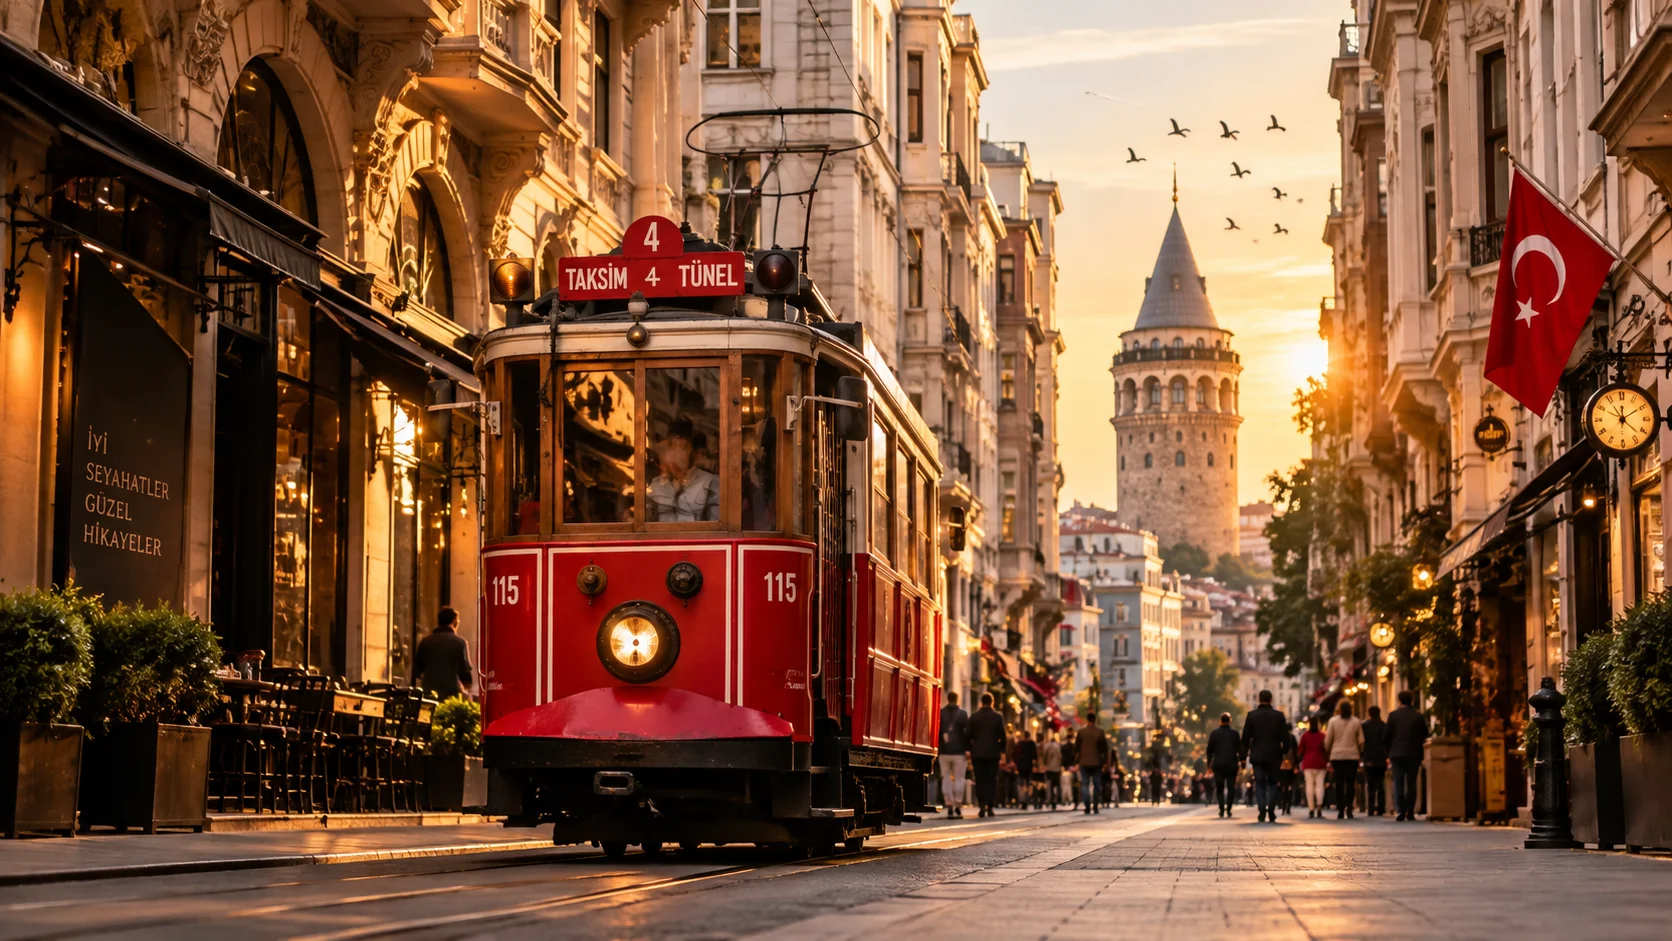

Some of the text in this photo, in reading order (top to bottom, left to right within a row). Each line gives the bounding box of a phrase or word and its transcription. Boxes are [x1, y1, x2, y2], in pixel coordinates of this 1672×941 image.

[644, 222, 659, 252] 4
[565, 260, 739, 291] TAKSİM 4 TÜNEL
[88, 425, 108, 455] İYİ
[86, 462, 169, 500] SEYAHATLER
[85, 491, 132, 521] GÜZEL
[84, 522, 162, 556] HİKAYELER
[492, 575, 519, 605] 115
[764, 571, 797, 602] 115
